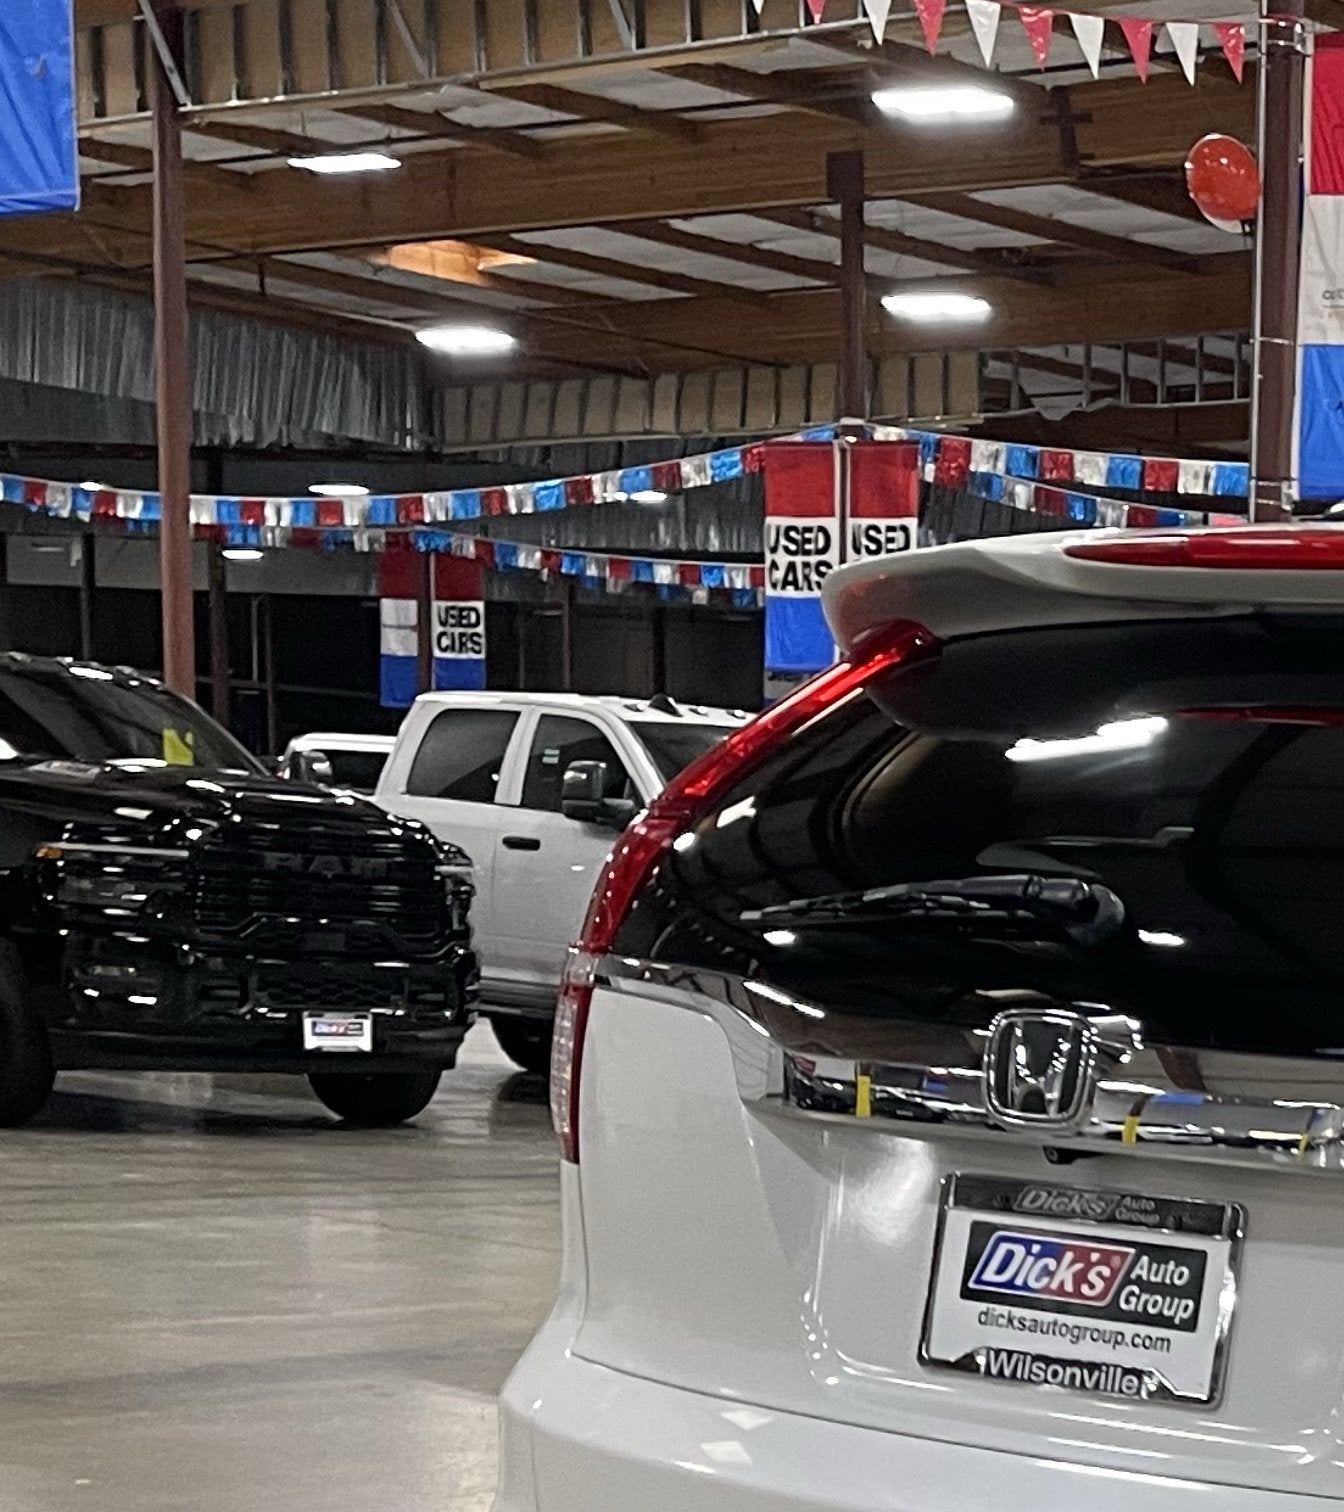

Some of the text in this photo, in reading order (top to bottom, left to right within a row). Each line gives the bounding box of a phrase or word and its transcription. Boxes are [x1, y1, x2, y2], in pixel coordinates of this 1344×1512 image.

[767, 524, 832, 556] USED
[852, 524, 911, 555] USED
[769, 559, 833, 591] CARS
[437, 605, 481, 628] USED
[980, 1242, 1111, 1297] Dick's
[1131, 1255, 1190, 1286] Auto
[1119, 1285, 1195, 1324] Group
[978, 1306, 1172, 1353] dicksautogroup.com
[989, 1350, 1140, 1395] Wilsonville
